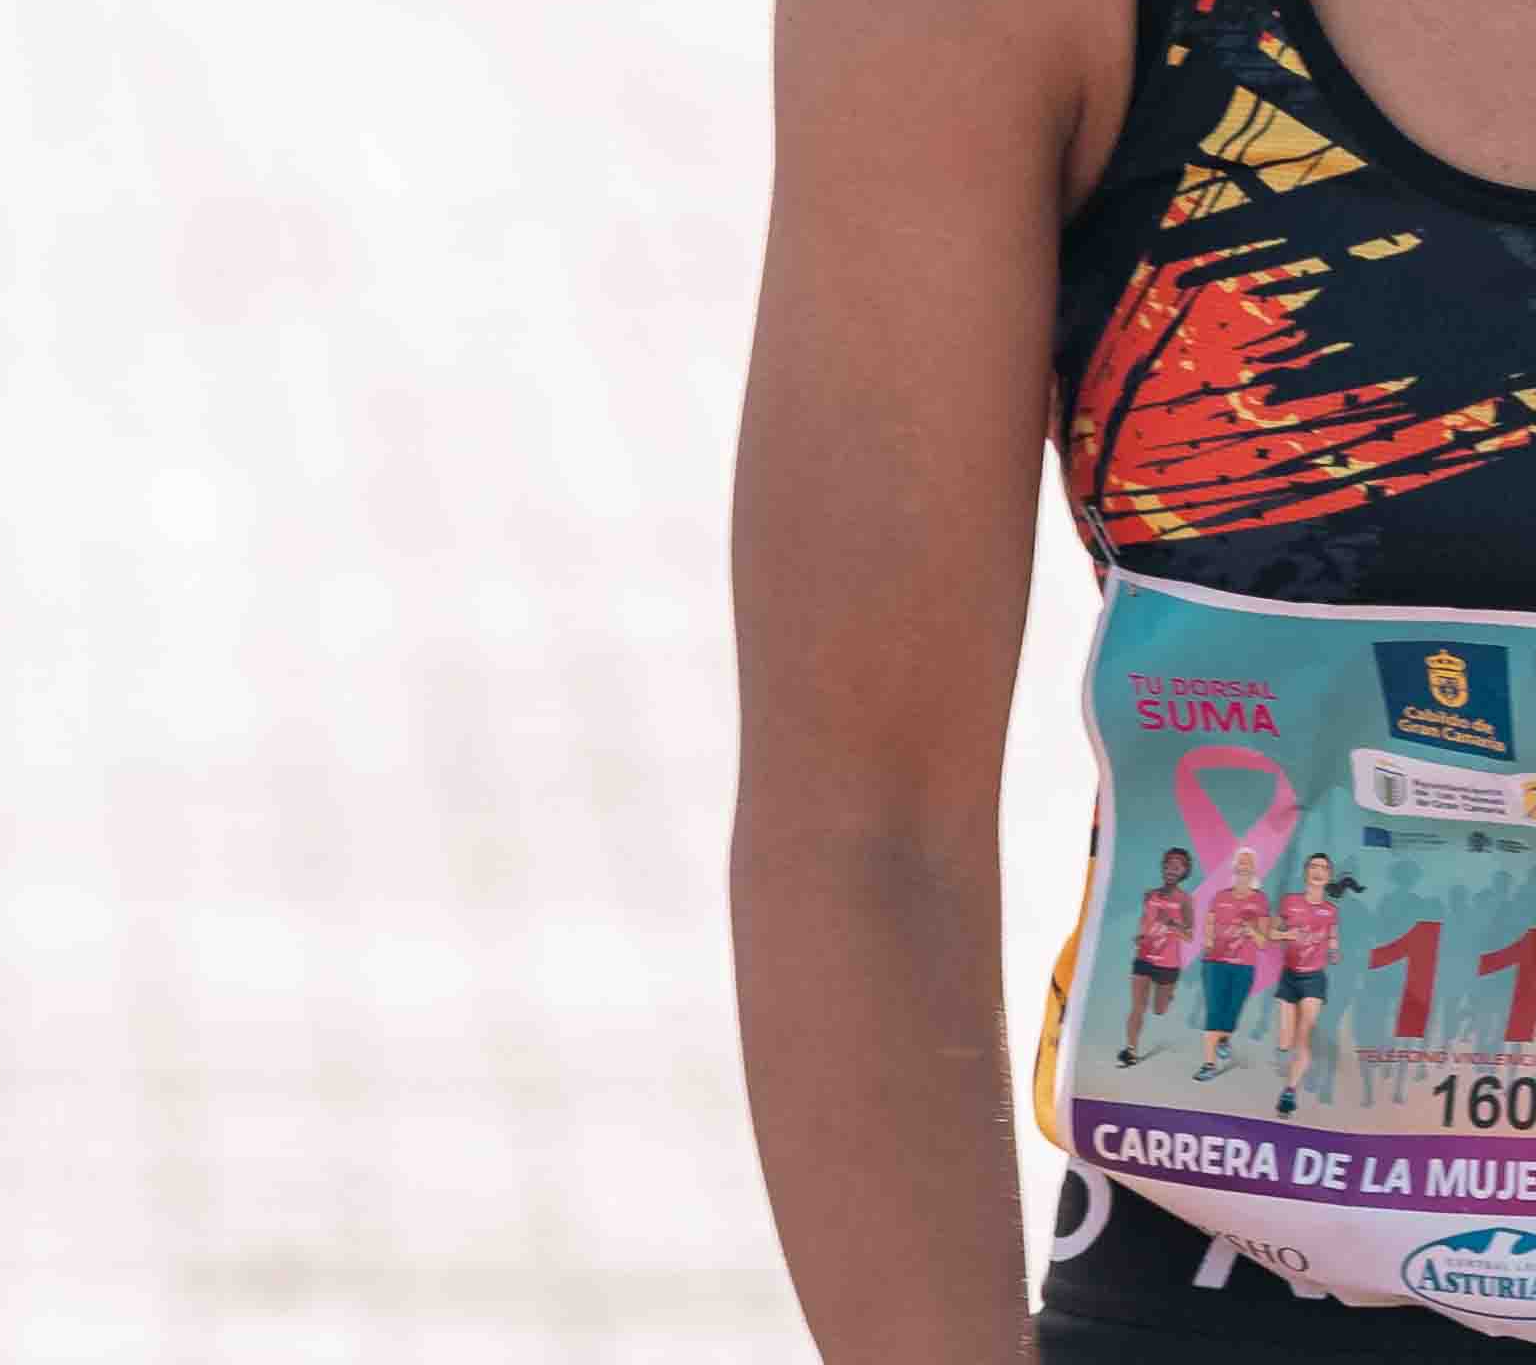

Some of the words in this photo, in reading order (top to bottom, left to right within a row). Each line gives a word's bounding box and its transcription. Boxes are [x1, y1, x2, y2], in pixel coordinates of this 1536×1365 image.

[1127, 671, 1163, 696] TU
[1169, 676, 1280, 700] DORSAL
[1136, 698, 1281, 738] SUMA
[1093, 1123, 1280, 1183] CARRERA
[1292, 1147, 1352, 1190] DE
[1360, 1156, 1412, 1196] LA
